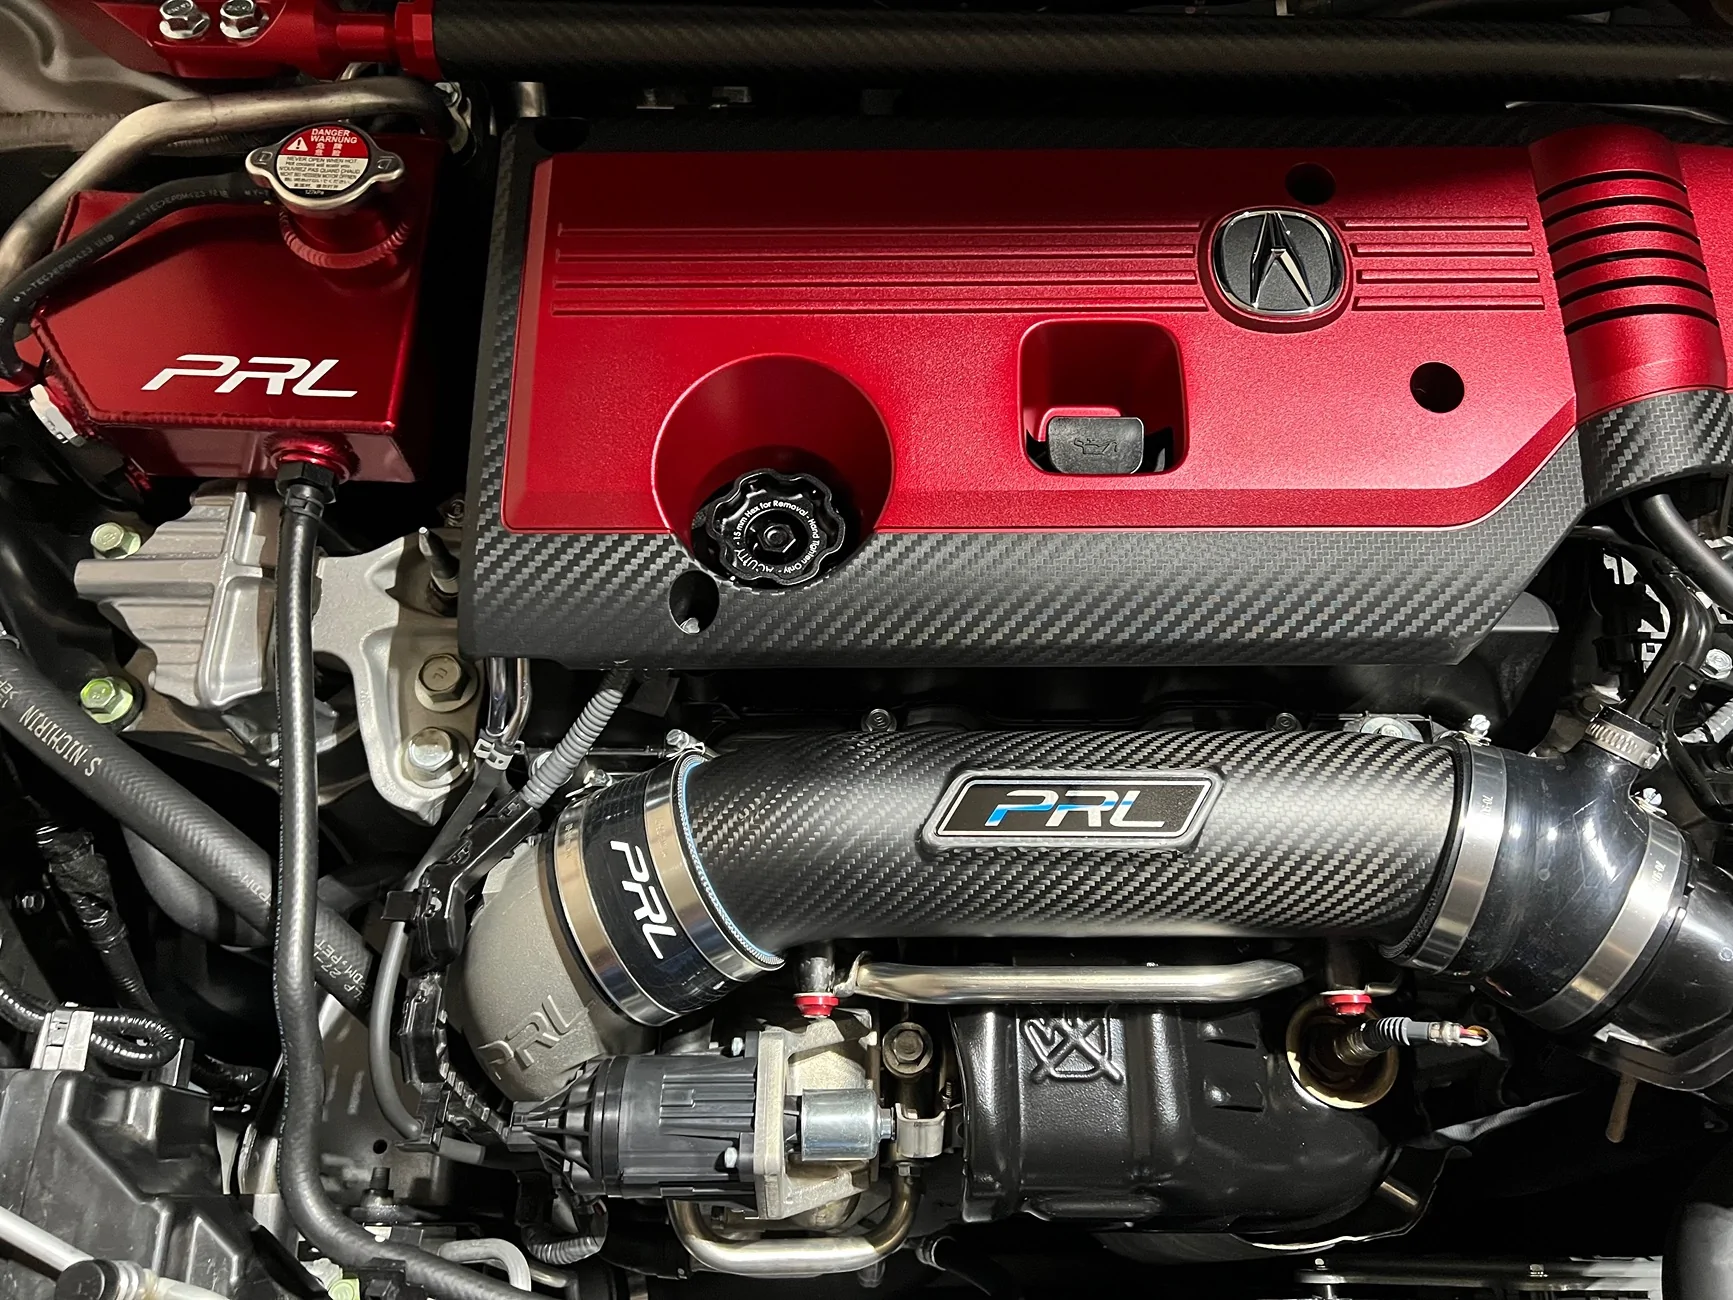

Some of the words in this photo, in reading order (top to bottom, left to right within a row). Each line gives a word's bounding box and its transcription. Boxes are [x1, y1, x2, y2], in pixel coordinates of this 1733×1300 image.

[310, 136, 358, 144] WARNUNG
[311, 128, 351, 137] DANGER
[140, 353, 359, 398] PRL
[745, 505, 761, 518] Hex
[759, 500, 772, 510] for
[773, 499, 807, 517] Removal
[736, 515, 748, 531] mm
[807, 518, 820, 539] Hand
[732, 531, 742, 541] 15
[734, 548, 775, 573] ACUITY
[801, 539, 820, 564] Tighten
[783, 563, 802, 574] Only
[983, 789, 1167, 828] PRL
[609, 840, 677, 960] PRL
[477, 994, 590, 1081] PRL
